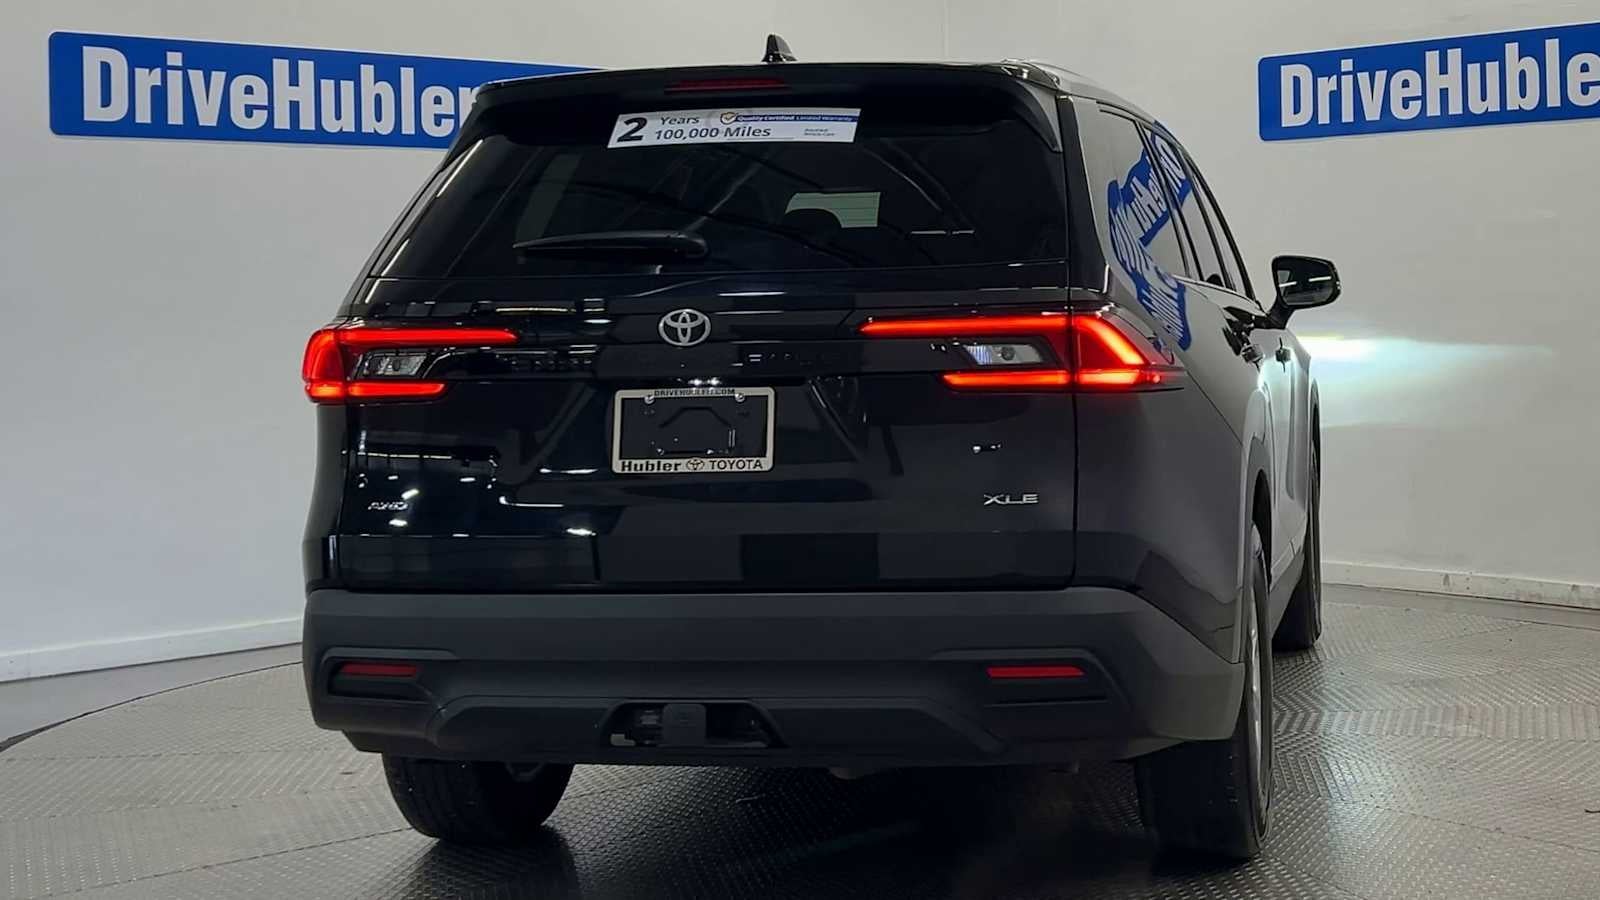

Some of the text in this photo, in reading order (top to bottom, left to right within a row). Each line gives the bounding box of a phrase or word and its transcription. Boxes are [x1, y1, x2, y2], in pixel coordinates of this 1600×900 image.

[1280, 38, 1600, 128] DriveHuble
[660, 115, 700, 126] Years
[616, 117, 648, 143] 2
[655, 126, 772, 141] 100,000 Miles
[621, 459, 764, 473] Hubler TOYOTA
[983, 493, 1039, 506] XLE
